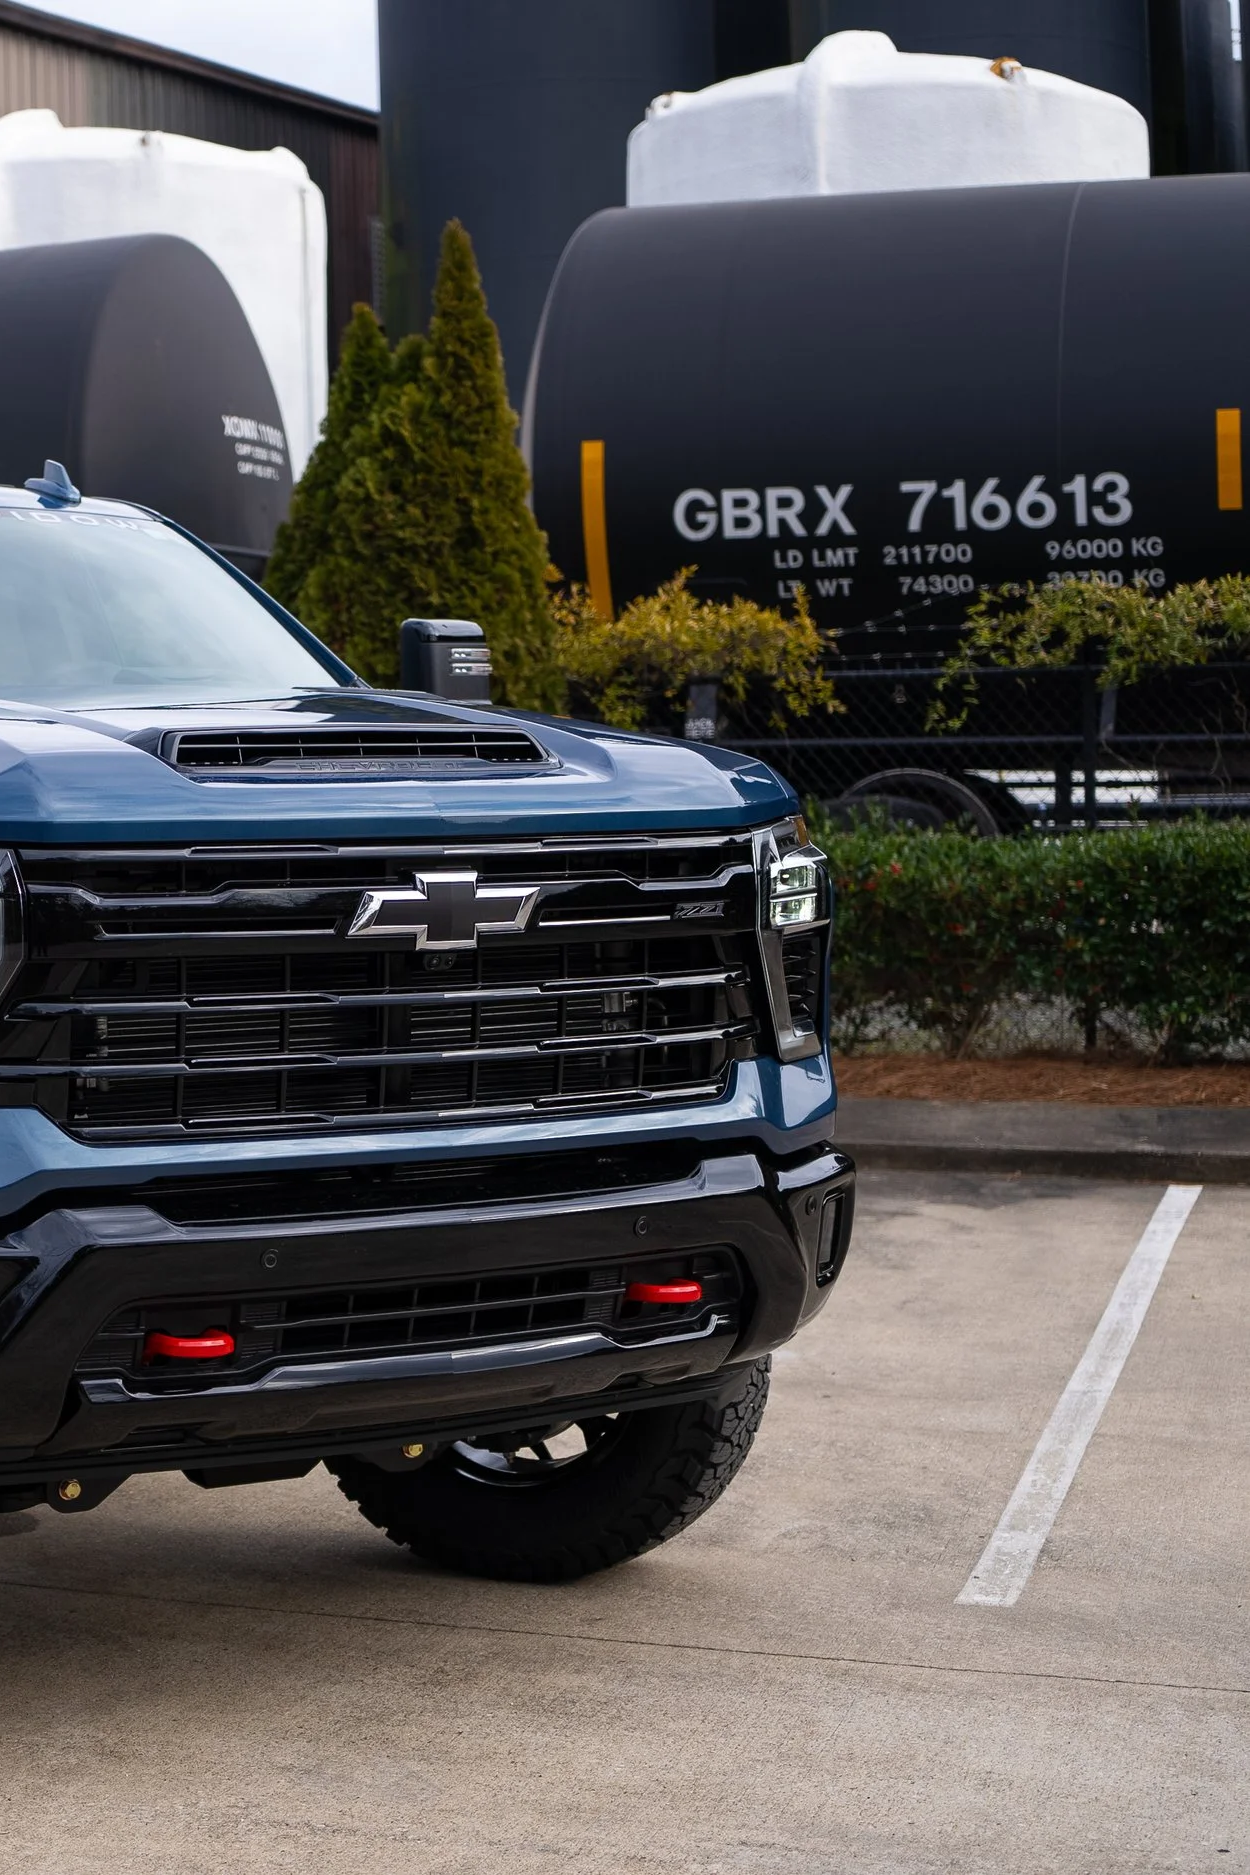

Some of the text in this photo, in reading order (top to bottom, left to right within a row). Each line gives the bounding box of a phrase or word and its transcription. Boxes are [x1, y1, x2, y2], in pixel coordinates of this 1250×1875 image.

[673, 472, 1133, 542] GBRX 716613
[773, 535, 1165, 569] LD LMT 211700 96000 KG
[777, 579, 803, 599] LT
[815, 577, 854, 598] WT
[897, 573, 975, 595] 74300
[1132, 567, 1167, 589] KG
[673, 900, 725, 920] Z71
